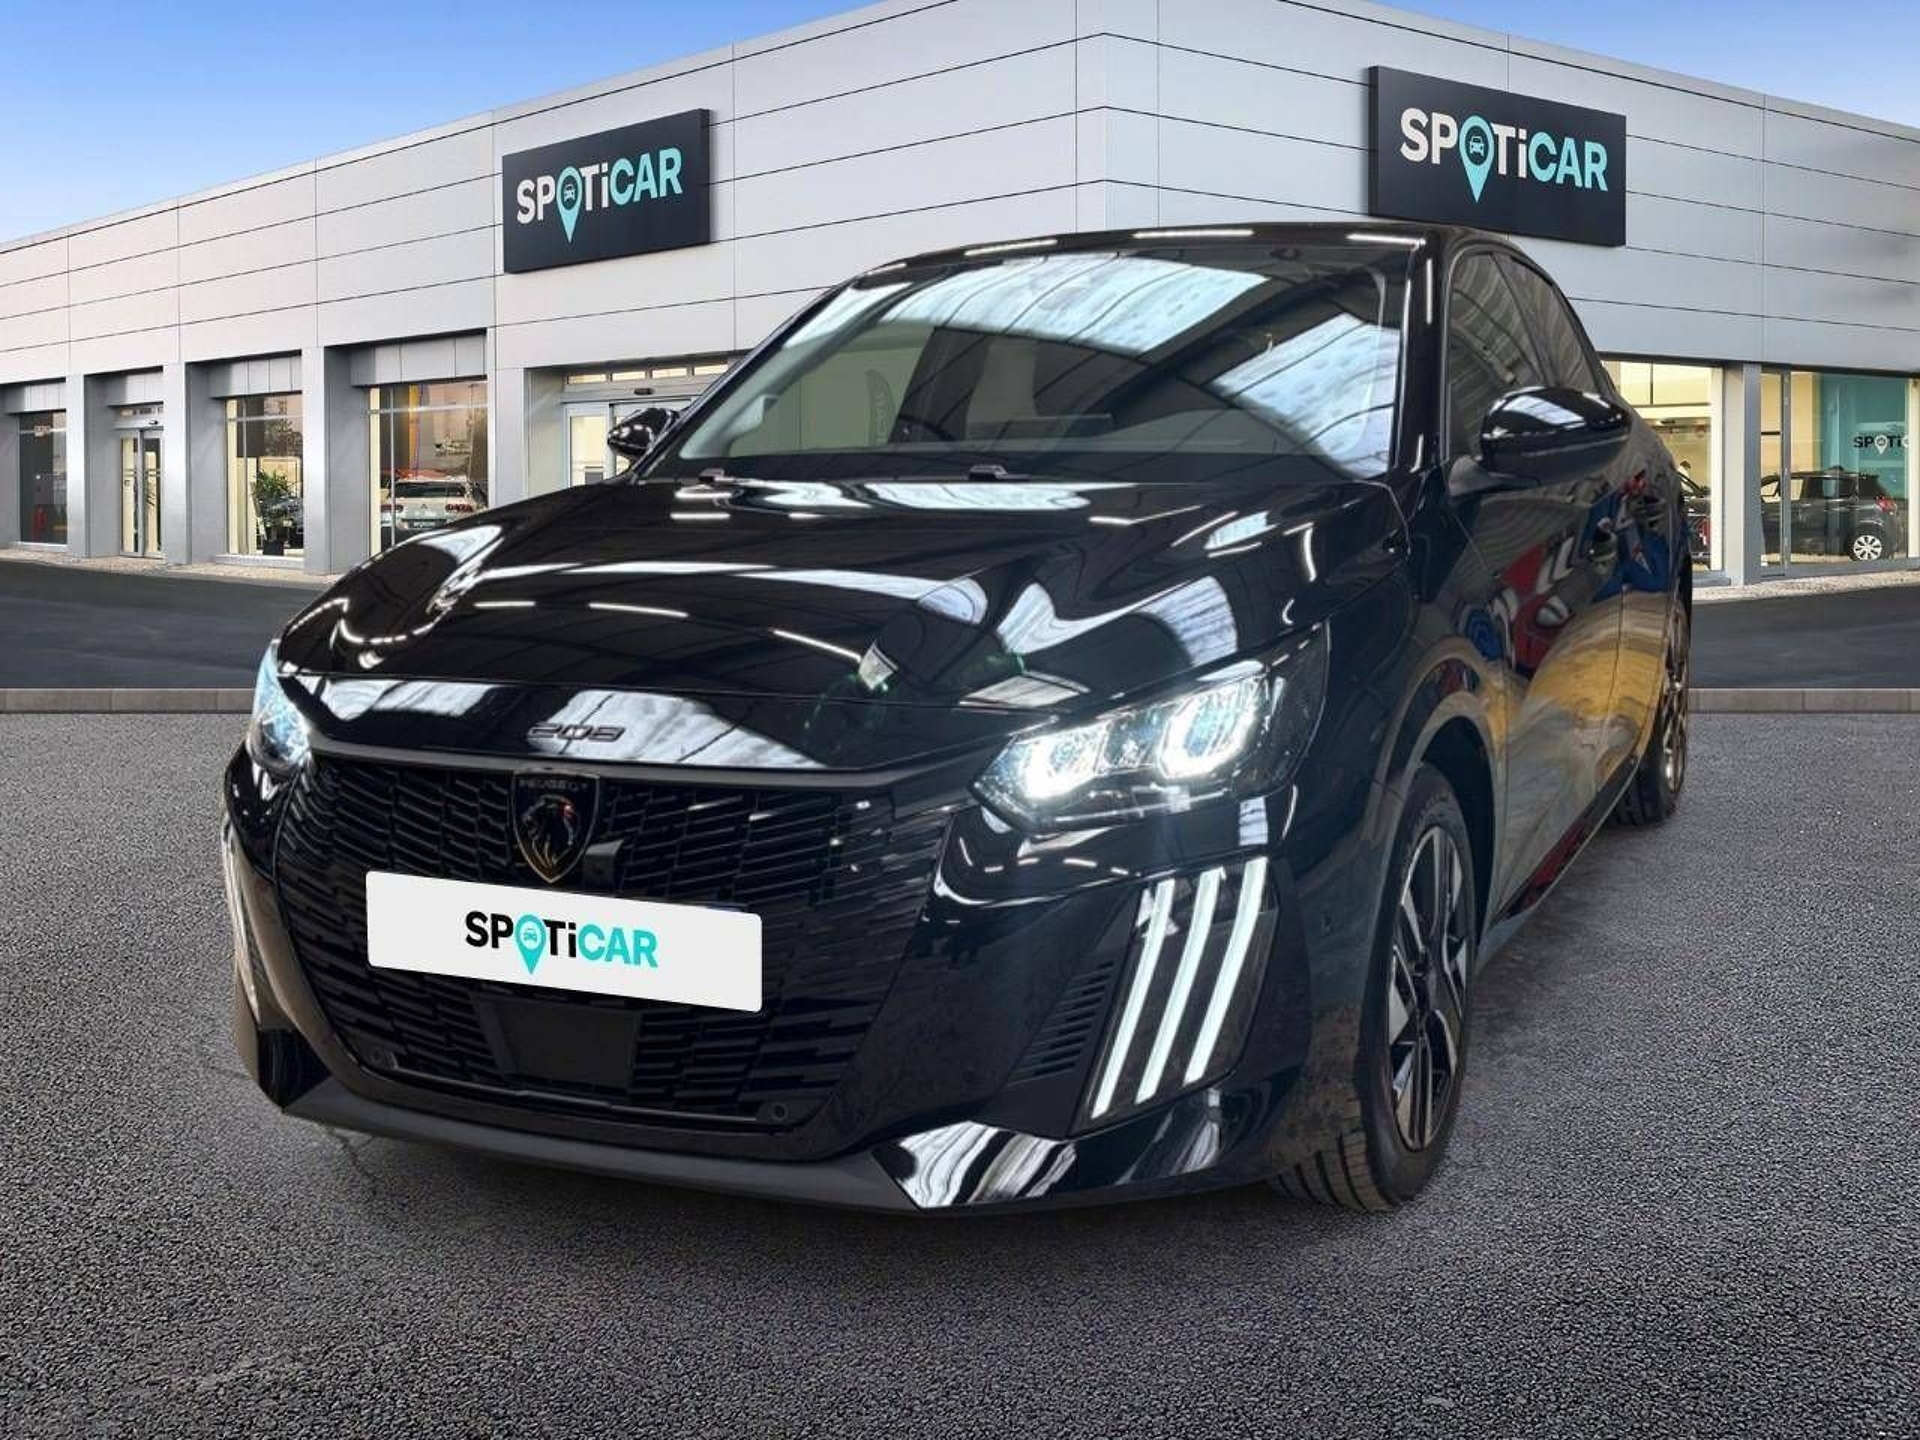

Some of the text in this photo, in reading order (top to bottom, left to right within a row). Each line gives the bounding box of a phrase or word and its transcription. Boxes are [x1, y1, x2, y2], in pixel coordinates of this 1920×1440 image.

[516, 147, 684, 243] SPOTiCAR
[1400, 107, 1609, 203] SPOTiCAR
[464, 910, 659, 976] SPOTiCAR
